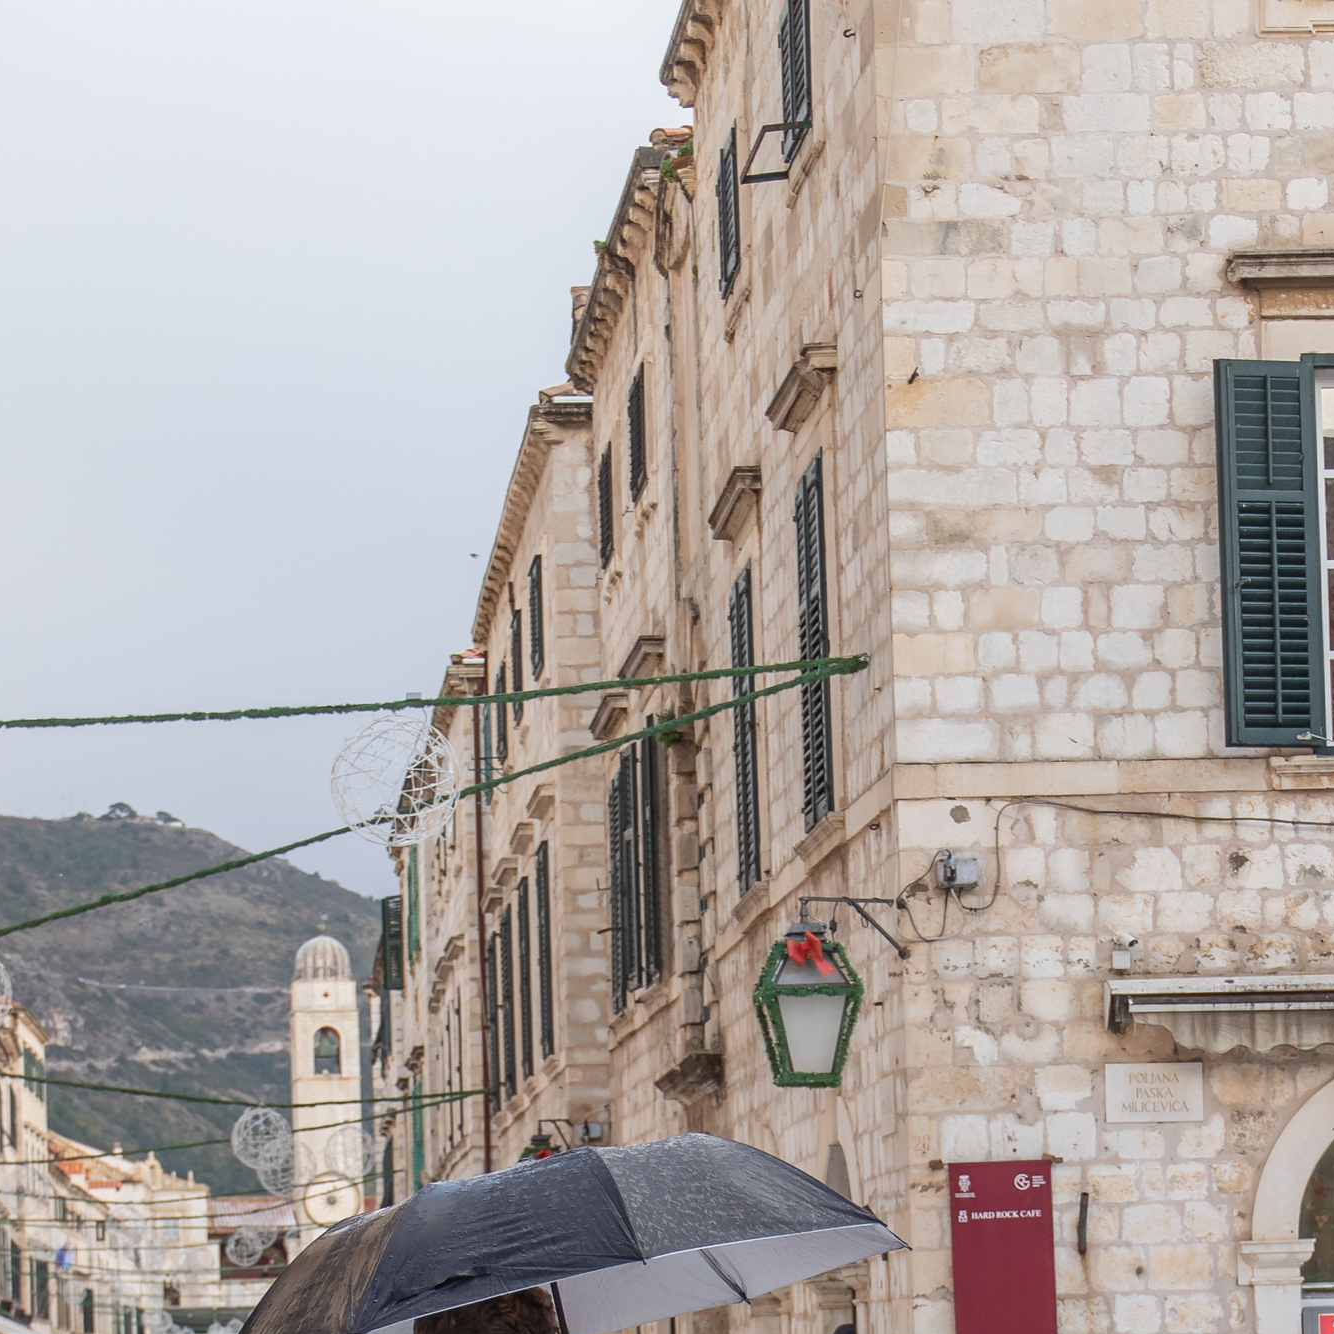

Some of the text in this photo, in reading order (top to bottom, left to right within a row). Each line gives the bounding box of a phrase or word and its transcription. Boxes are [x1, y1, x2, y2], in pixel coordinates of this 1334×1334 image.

[1128, 1072, 1180, 1084] POLJANA
[1136, 1087, 1174, 1098] PASKA
[971, 1211, 995, 1219] HARD
[996, 1210, 1019, 1218] ROCK
[1020, 1209, 1042, 1217] CAFE
